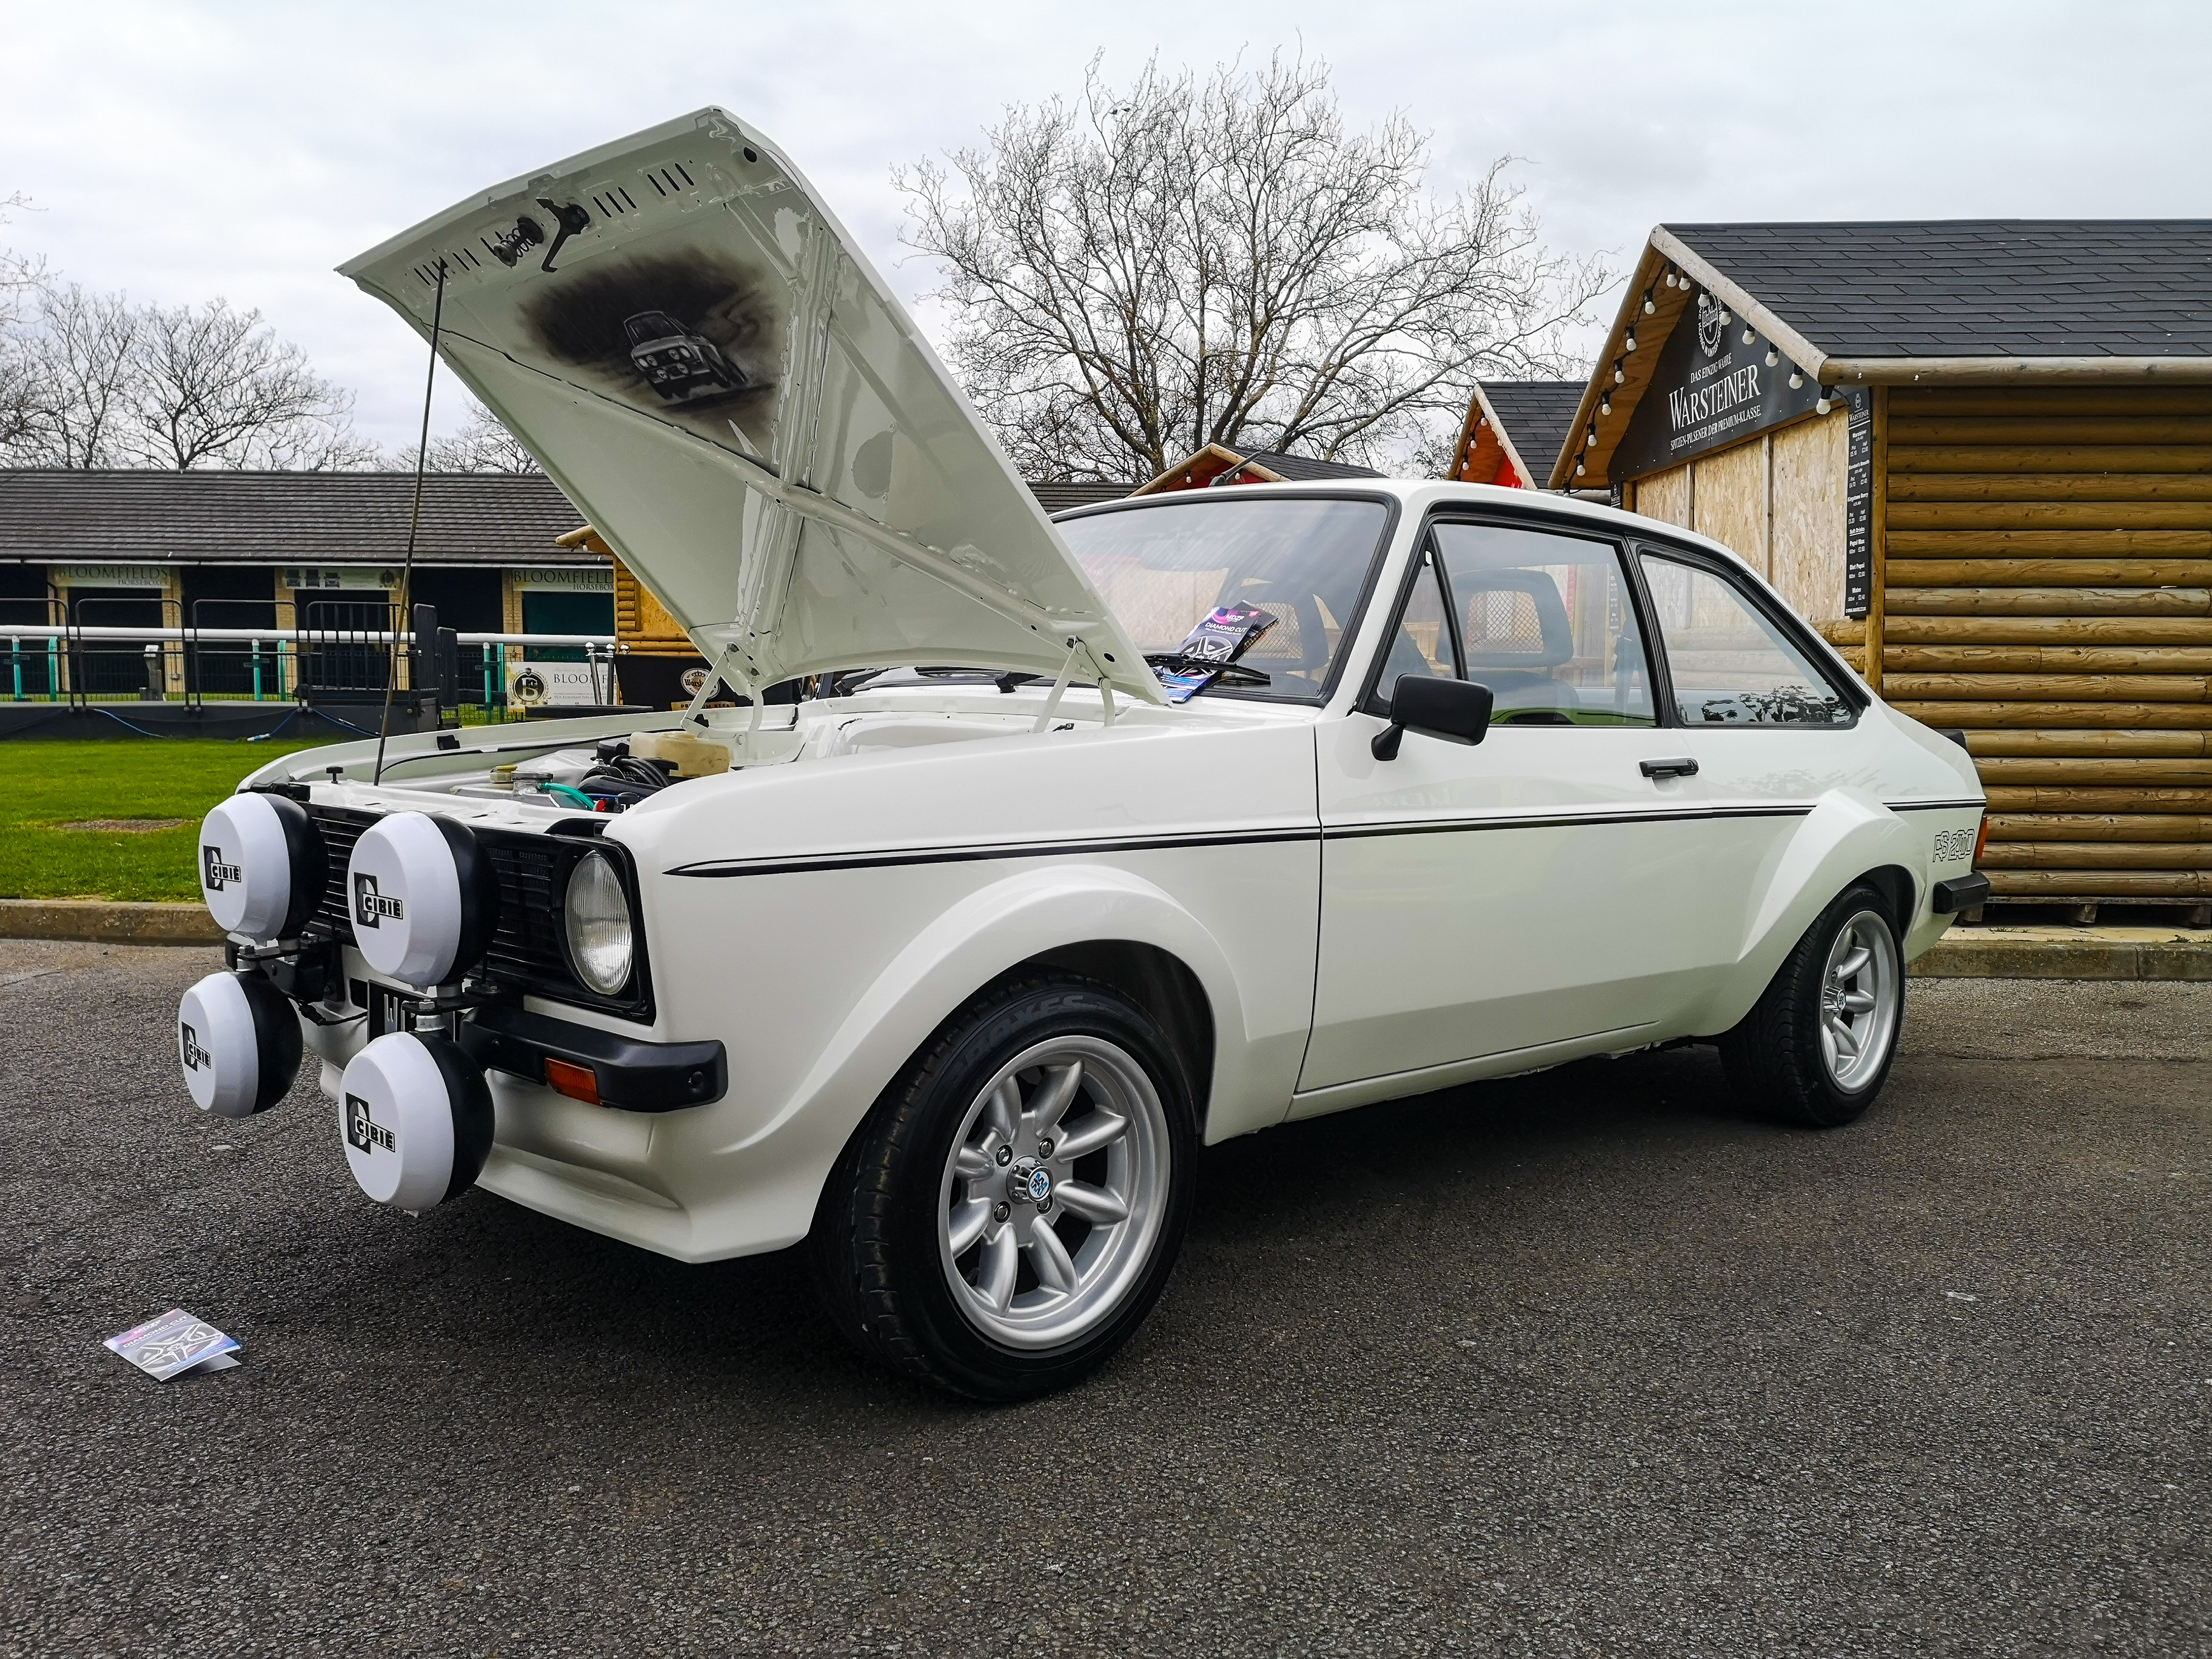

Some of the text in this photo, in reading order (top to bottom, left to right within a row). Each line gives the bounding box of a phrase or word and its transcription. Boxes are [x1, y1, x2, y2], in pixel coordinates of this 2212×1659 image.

[1691, 353, 1732, 383] DAS EINZIG WAHRE
[1669, 364, 1761, 432] WARSTEINER
[1671, 427, 1708, 451] SPITZEN-PILSENER
[1708, 423, 1717, 435] DER
[514, 570, 614, 583] BLOOMFIELD
[1205, 622, 1235, 632] DIAMOND
[1932, 830, 1949, 862] RS
[122, 1324, 169, 1348] DIAMOND
[170, 1315, 187, 1325] CUT
